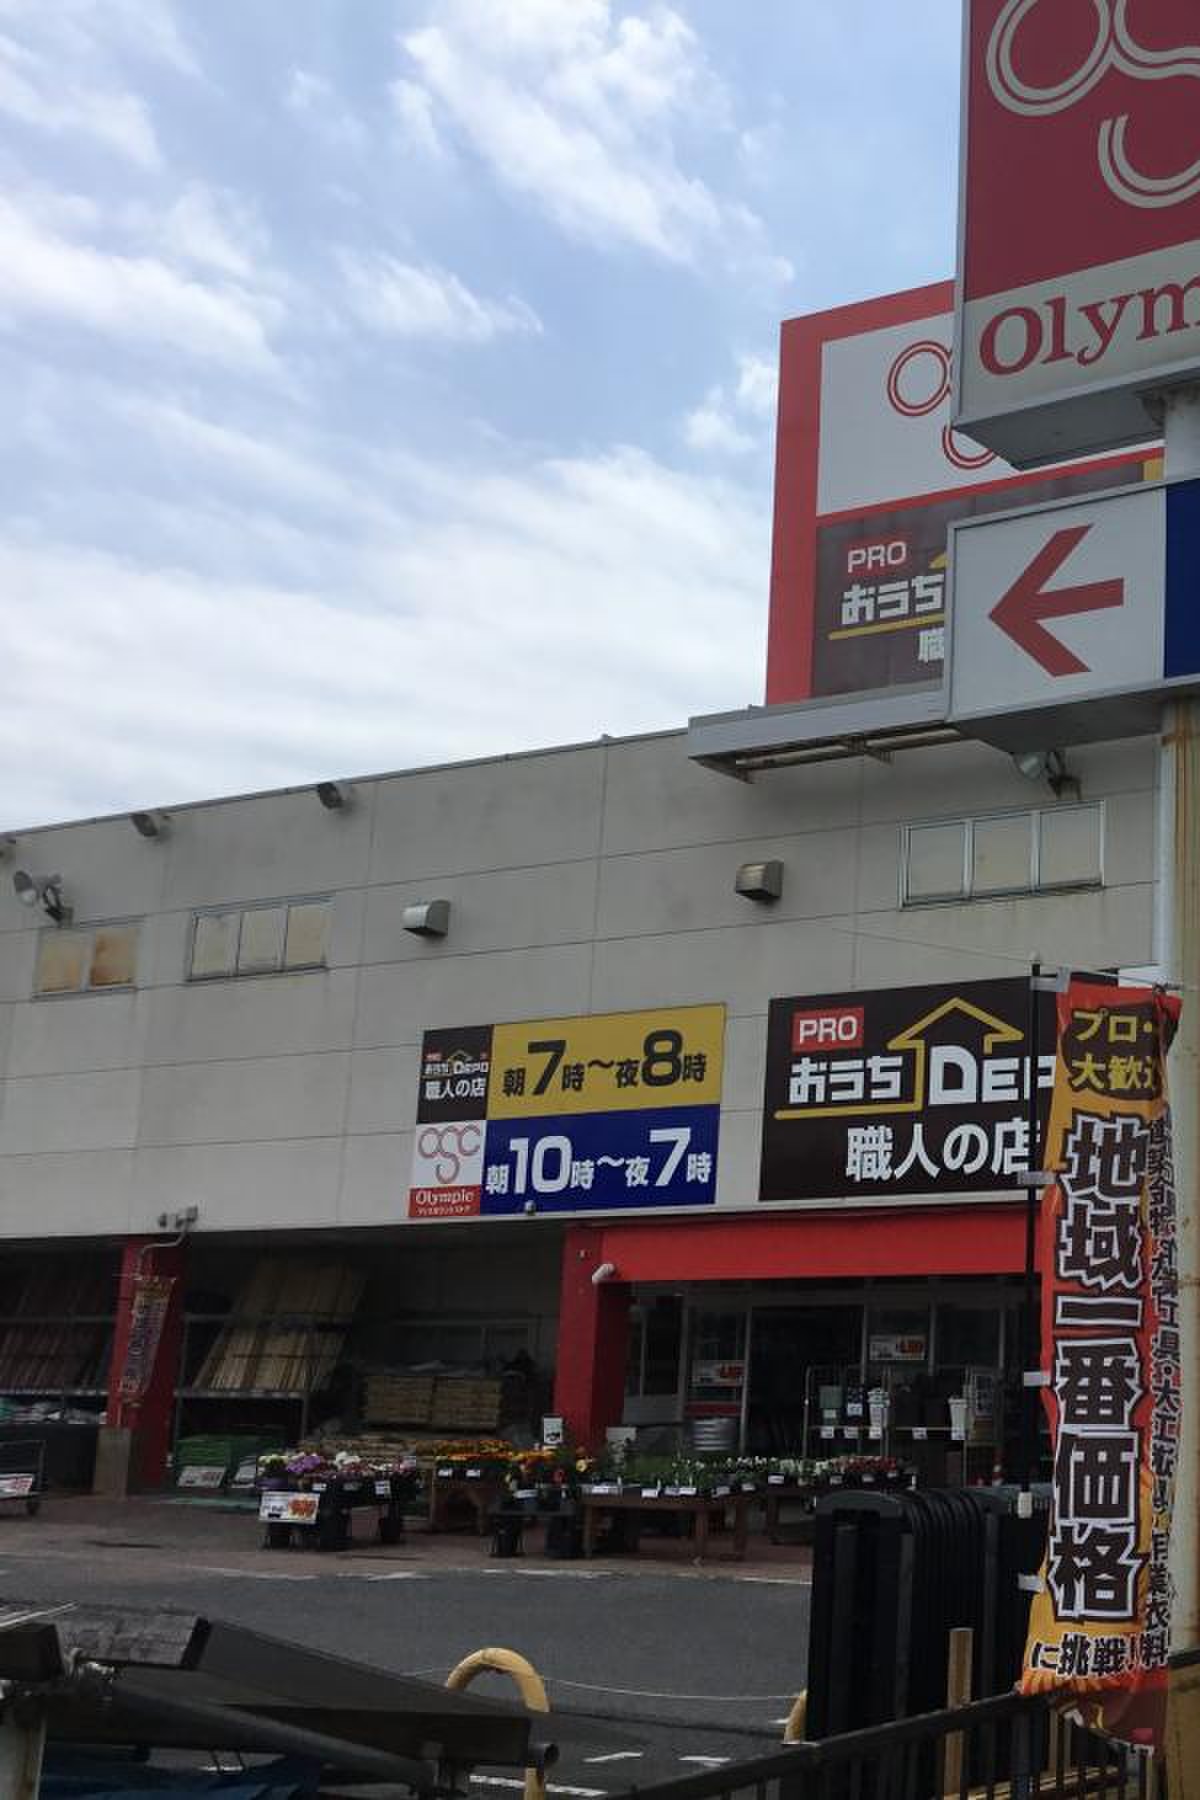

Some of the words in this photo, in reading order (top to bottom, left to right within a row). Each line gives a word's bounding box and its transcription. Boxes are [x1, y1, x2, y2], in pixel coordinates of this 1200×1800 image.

[847, 541, 907, 573] PRO
[799, 1016, 858, 1044] PRO
[846, 1119, 1042, 1182] 職人の店
[1049, 1114, 1147, 1620] 地域一番価格
